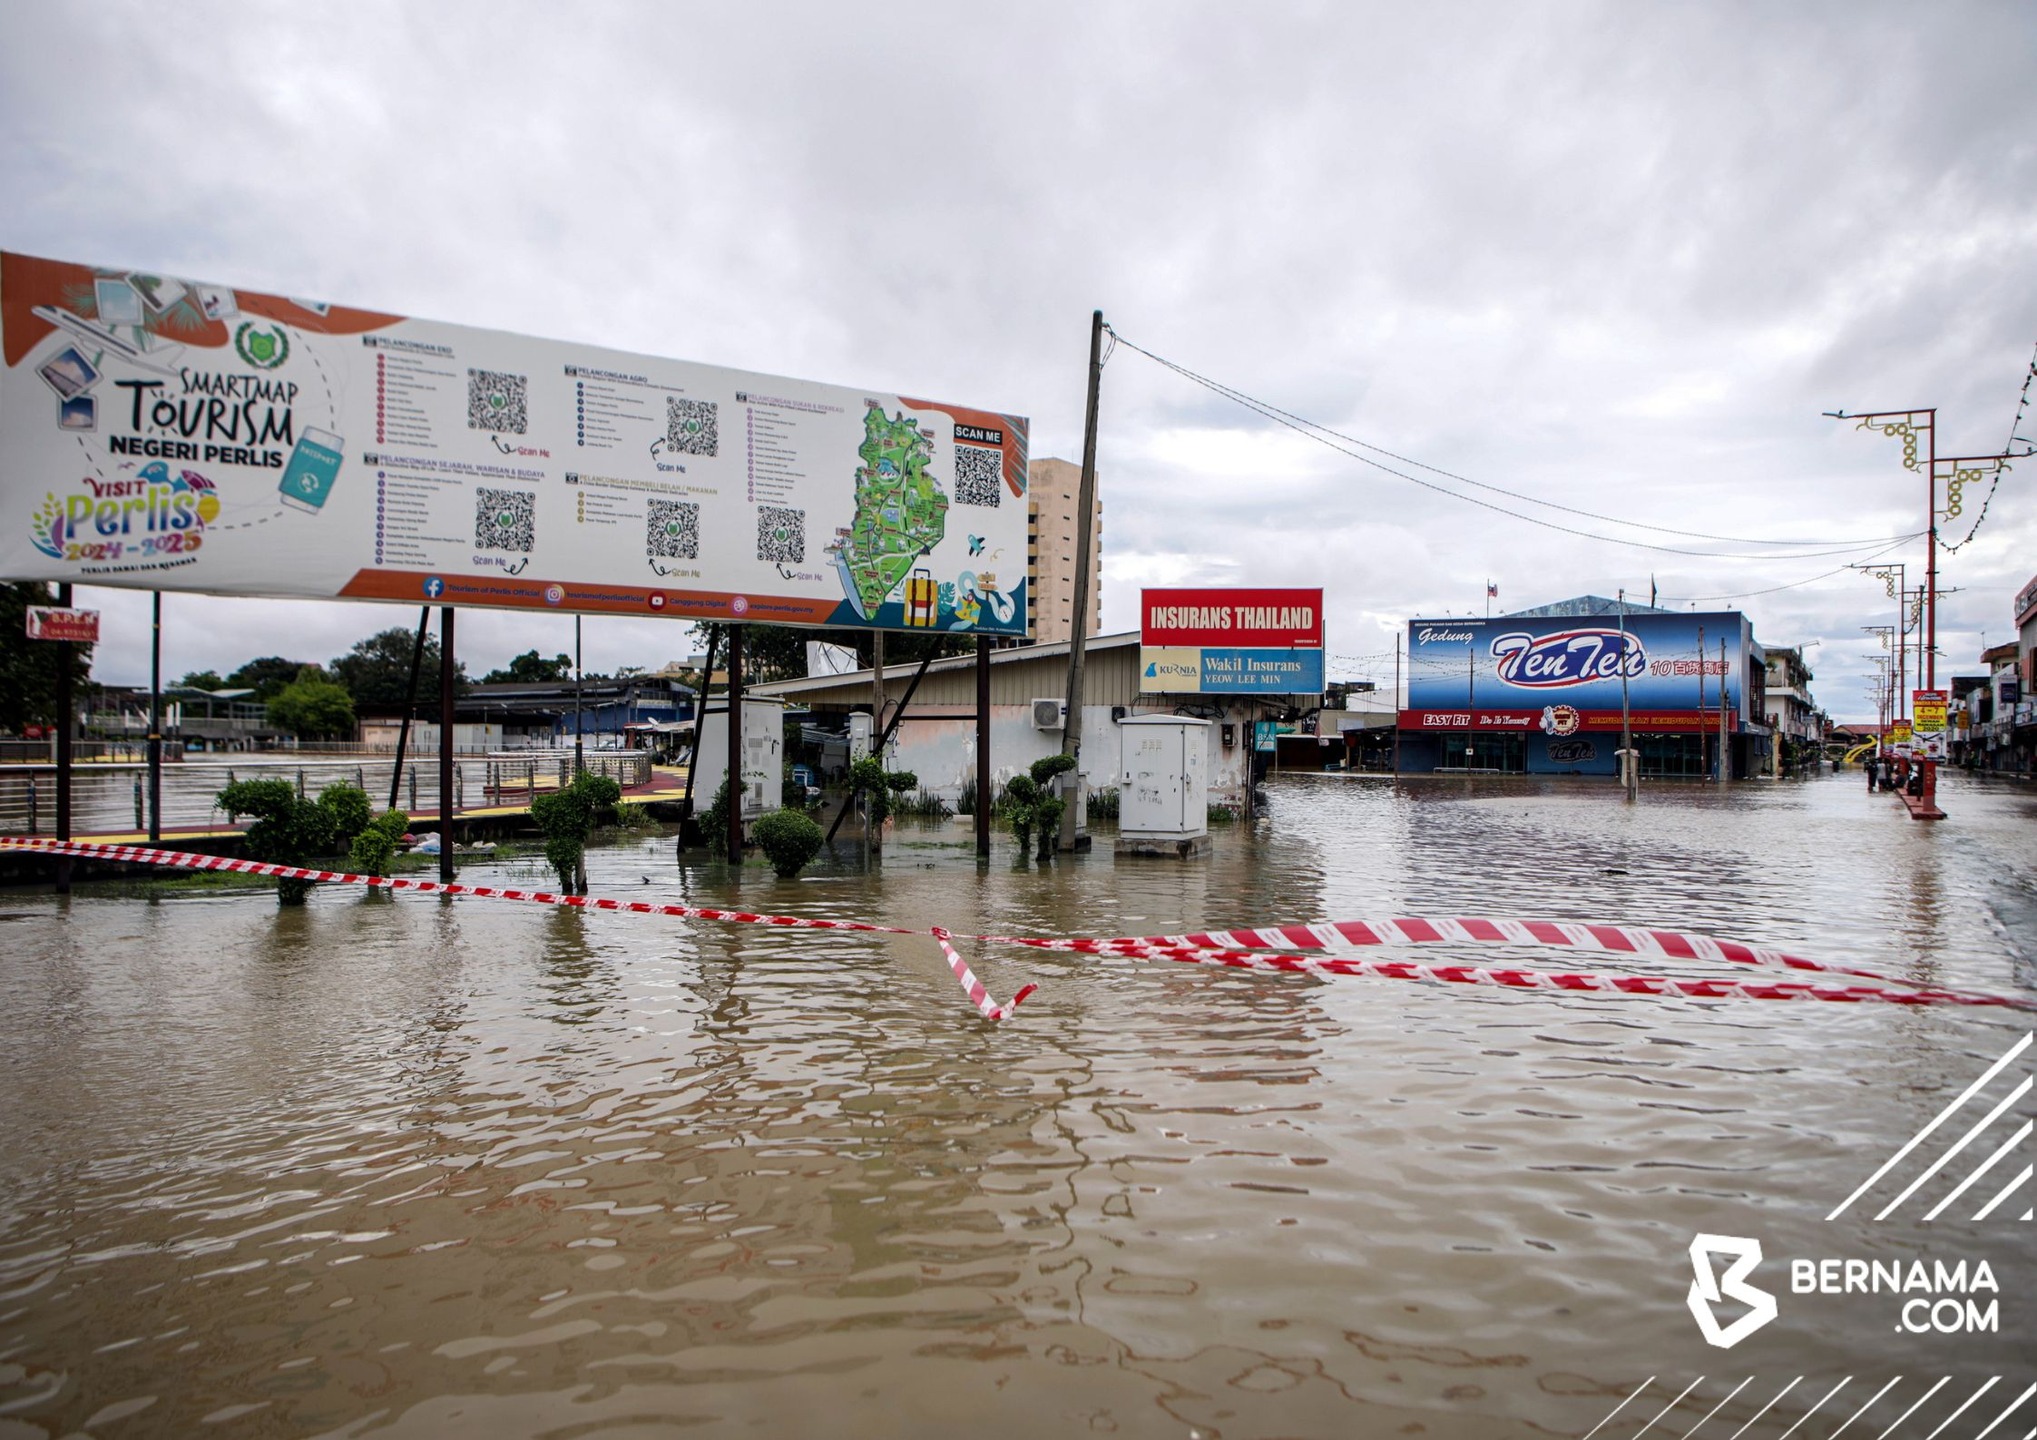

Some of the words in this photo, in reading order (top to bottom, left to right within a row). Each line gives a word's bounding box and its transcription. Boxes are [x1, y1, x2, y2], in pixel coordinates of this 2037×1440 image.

[578, 367, 628, 380] PELANCONGAN
[180, 367, 298, 405] SMARTMAP
[955, 426, 983, 440] SCAN
[986, 431, 1000, 442] ME
[110, 434, 198, 460] NEGERI
[204, 444, 282, 468] PERLIS
[518, 446, 538, 456] Scan
[540, 448, 550, 458] Me
[380, 454, 437, 467] PELANCONGAN
[439, 460, 474, 471] SEJARAH,
[476, 464, 509, 474] WARISAN
[518, 469, 545, 478] BUDAYA
[656, 462, 674, 472] Scan
[676, 464, 686, 474] Me
[83, 477, 147, 497] VISIT
[579, 474, 630, 485] PELANCONGAN
[660, 483, 681, 491] BELAH
[686, 485, 718, 495] MAKANAN
[66, 486, 195, 539] Perlis
[472, 555, 493, 565] Scan
[495, 557, 506, 566] Me
[672, 569, 689, 577] Scan
[691, 570, 700, 578] Me
[797, 573, 812, 581] Scan
[814, 573, 822, 581] Me
[448, 584, 479, 594] Tourism
[480, 585, 489, 593] of
[490, 587, 512, 595] Perlis
[513, 588, 540, 597] Official
[669, 598, 704, 608] Canggung
[706, 600, 727, 609] Digital
[1151, 606, 1231, 629] INSURANS
[1235, 606, 1312, 629] THAILAND
[1418, 628, 1474, 646] Gedung
[1495, 636, 1568, 679] Ten
[1567, 636, 1643, 679] Ten
[1160, 664, 1196, 676] KURNIA
[1205, 658, 1242, 671] Wakil
[1247, 658, 1301, 672] Insurans
[1650, 661, 1671, 676] 10
[1674, 661, 1729, 676] 百货商店
[1205, 675, 1233, 683] YEOW
[1238, 675, 1256, 683] LEE
[1260, 675, 1280, 683] MIN
[1424, 714, 1452, 725] EASY
[1453, 714, 1470, 725] FIT
[1480, 715, 1492, 725] Do
[1493, 715, 1502, 725] It
[1588, 716, 1649, 725] MEMUDAKAN
[1704, 717, 1721, 725] AND
